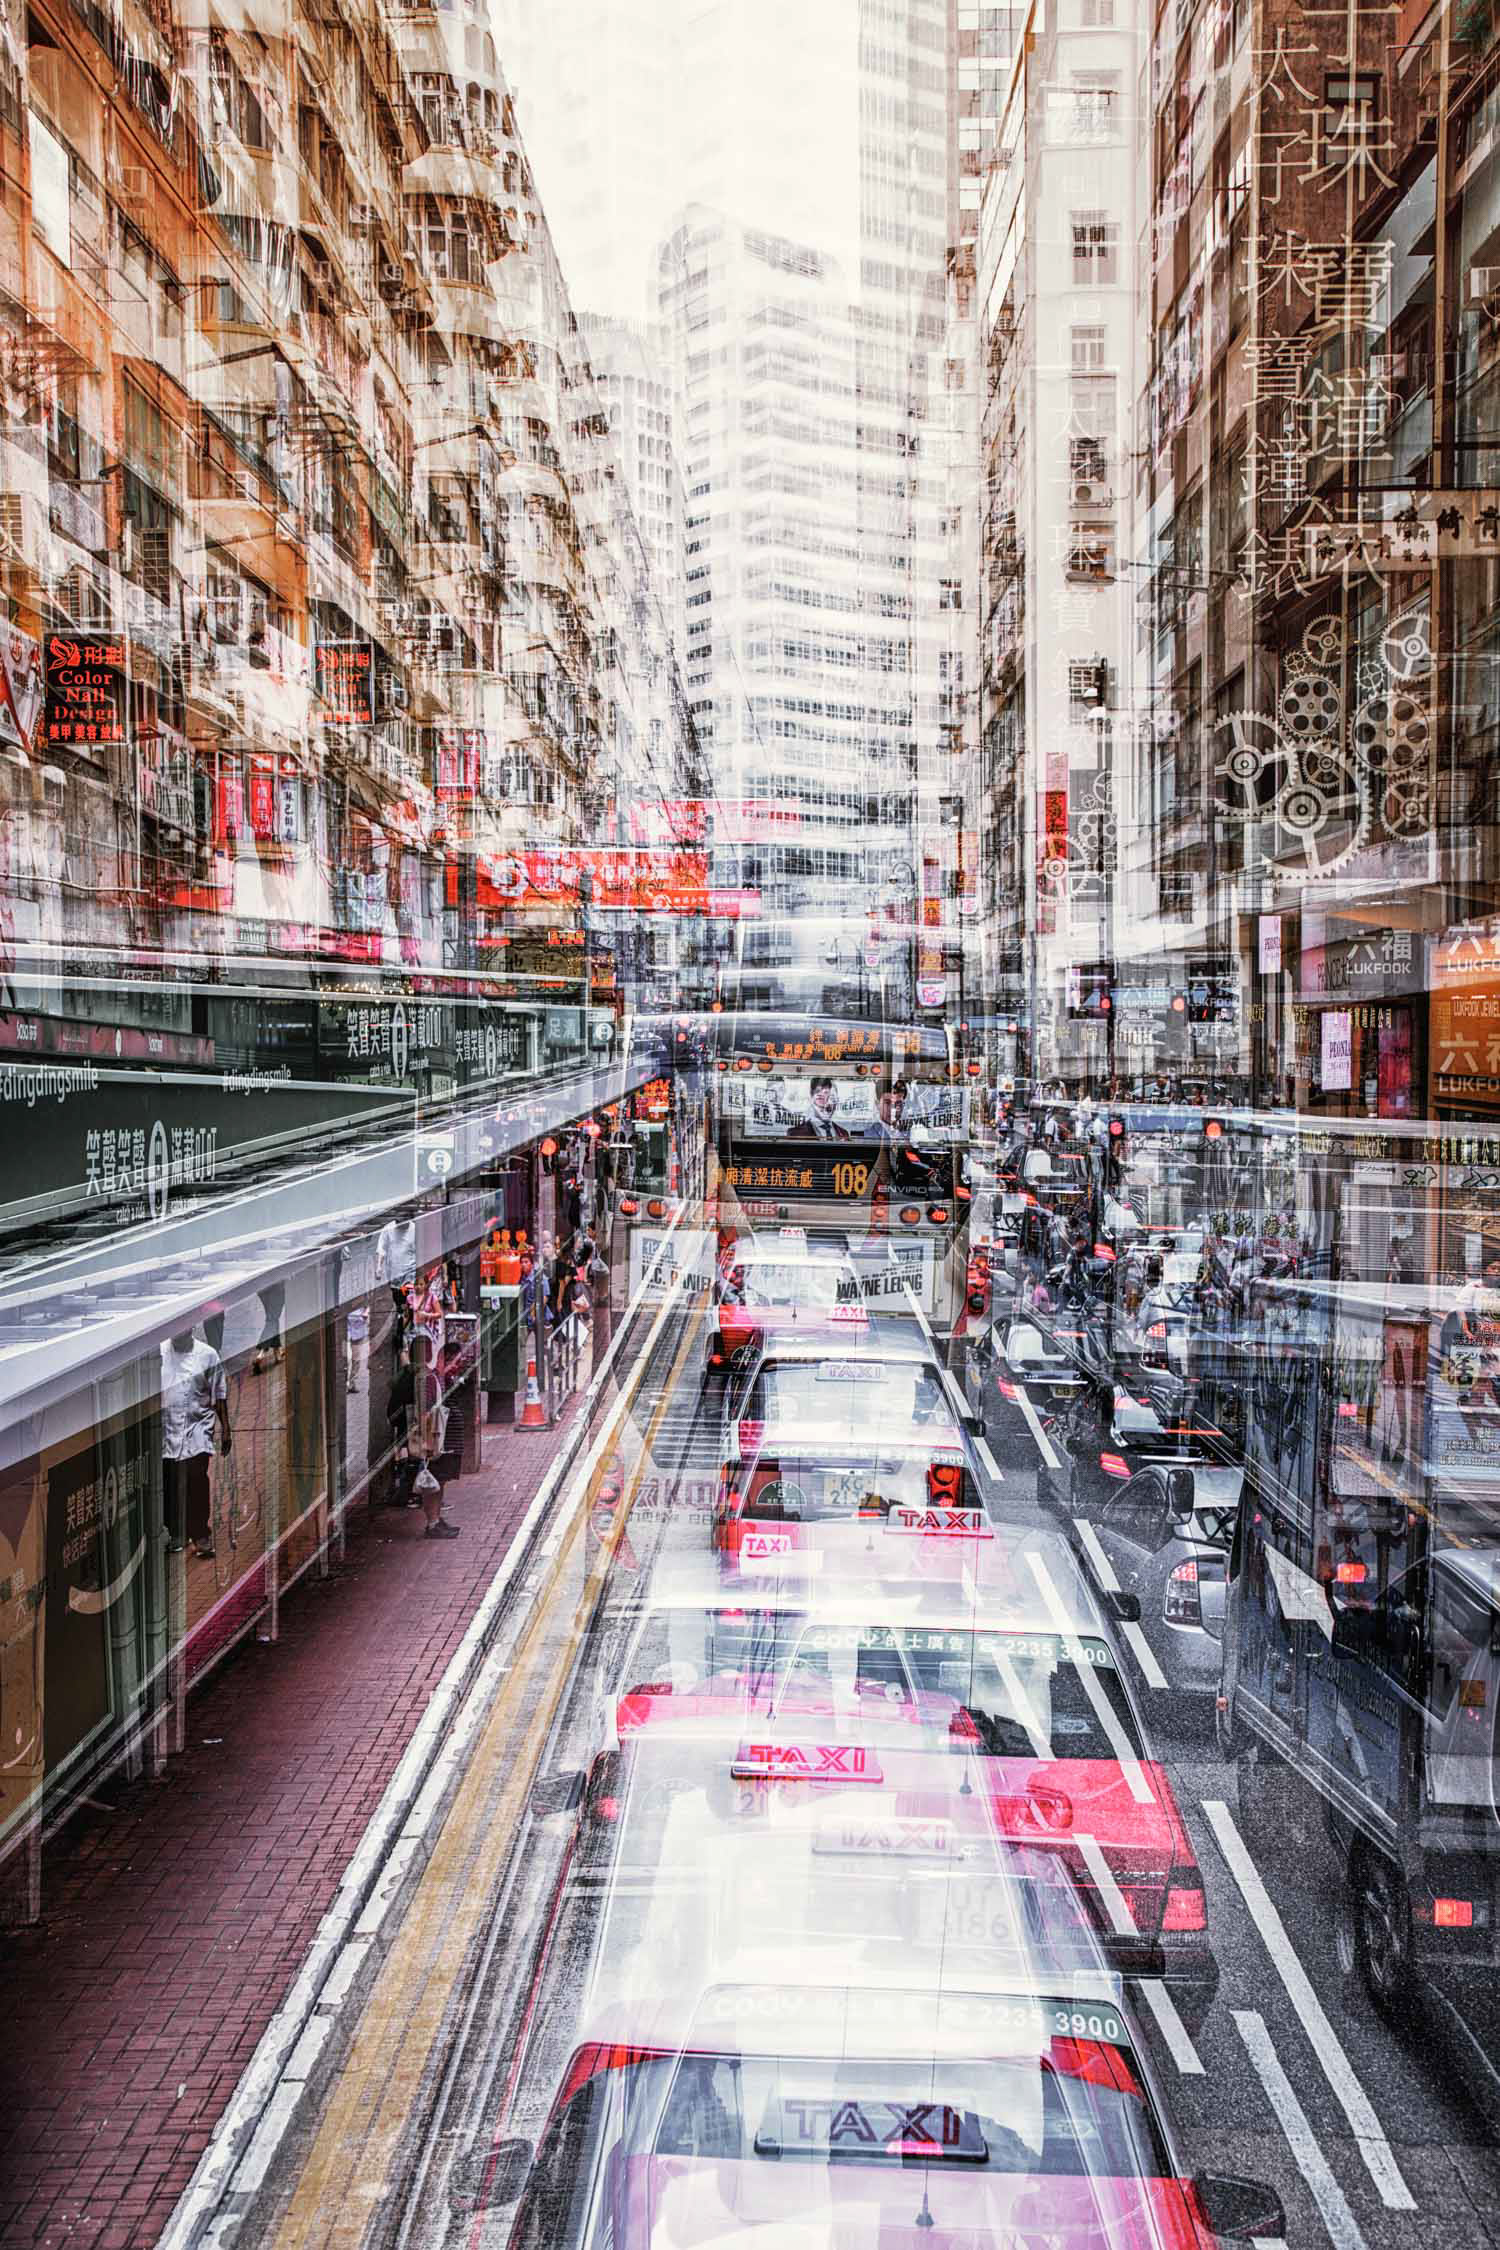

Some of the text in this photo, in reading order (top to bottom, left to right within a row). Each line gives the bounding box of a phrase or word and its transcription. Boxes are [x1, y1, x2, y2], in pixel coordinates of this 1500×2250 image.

[58, 670, 113, 685] Color
[1345, 928, 1412, 961] 六福
[1447, 919, 1500, 955] 六
[1346, 962, 1412, 975] LUKFOOK
[831, 1162, 868, 1196] 108
[837, 1278, 881, 1299] WAYNE
[828, 1366, 882, 1379] TAXI
[897, 1509, 982, 1531] TAXI
[745, 1537, 789, 1552] TAXI
[1060, 1645, 1107, 1664] 3900
[750, 1745, 866, 1773] TAXI
[840, 1823, 947, 1850] TAXI
[1055, 2010, 1120, 2039] 3900
[784, 2098, 960, 2145] TAXI
